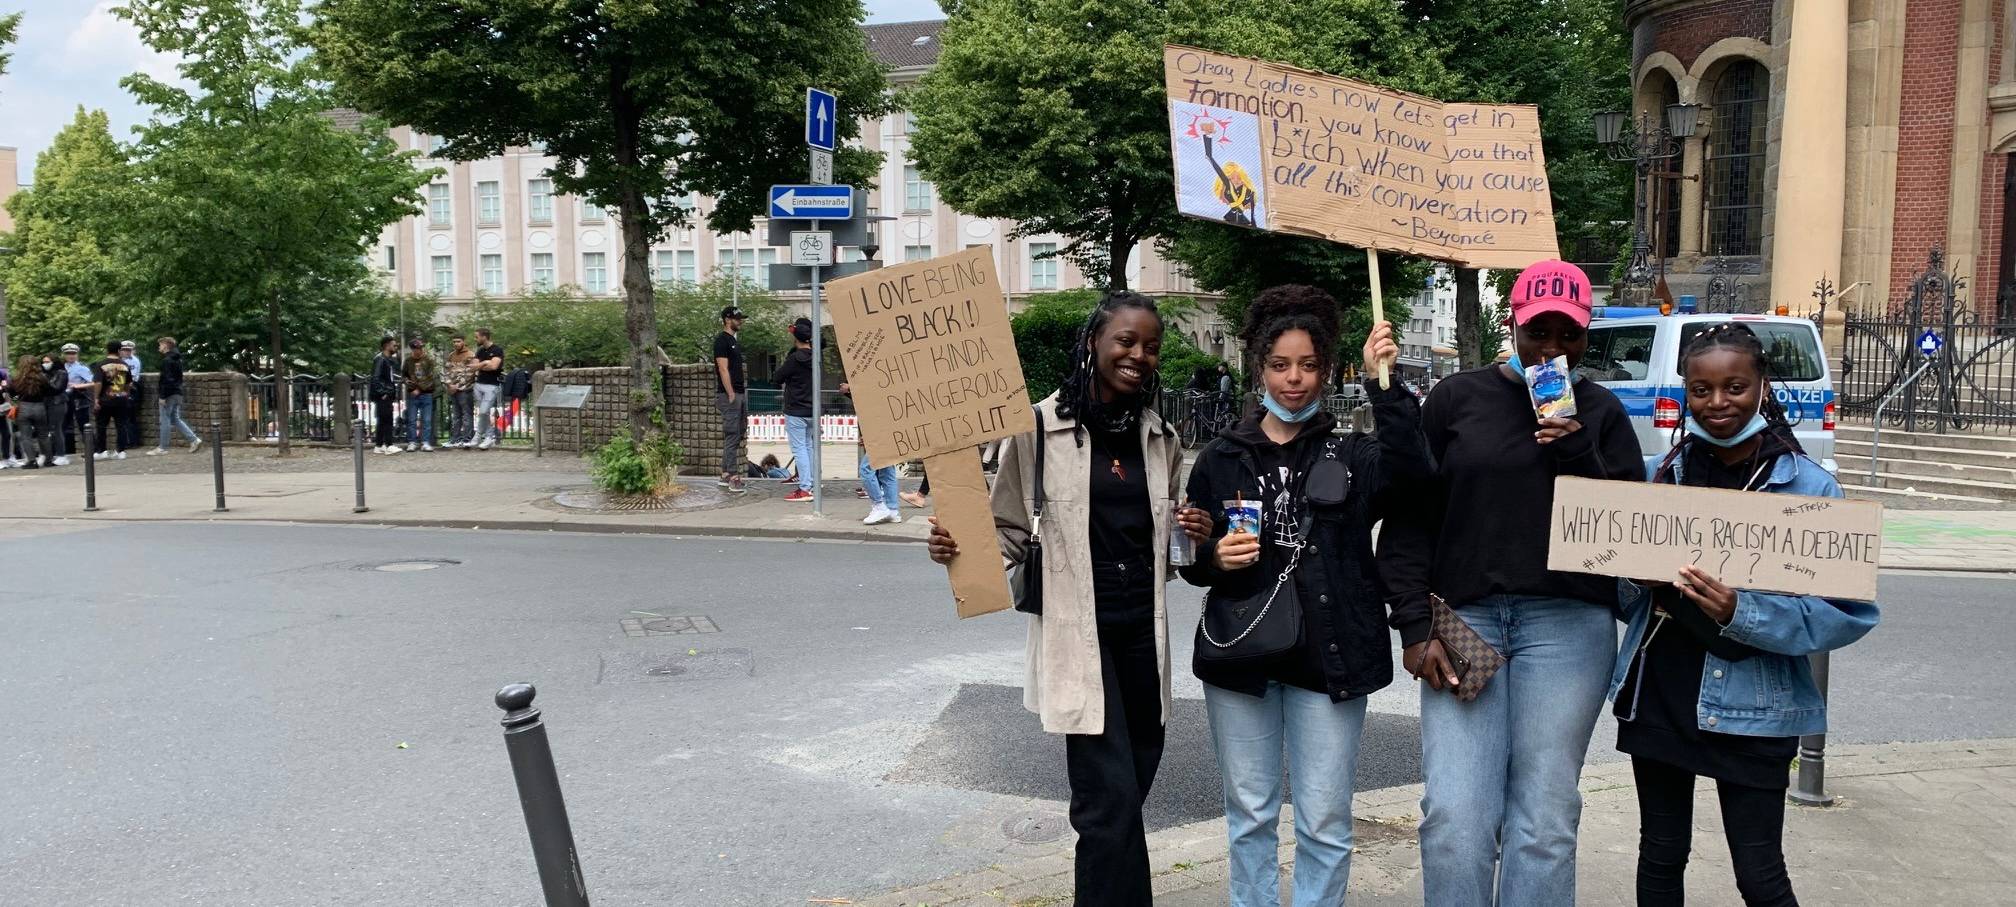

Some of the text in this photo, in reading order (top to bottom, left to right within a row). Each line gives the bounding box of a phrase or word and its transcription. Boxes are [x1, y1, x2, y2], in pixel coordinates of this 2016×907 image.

[1177, 52, 1234, 82] Okay
[1245, 65, 1319, 98] Ladies
[1332, 87, 1381, 113] now
[1444, 109, 1478, 136] get
[1492, 109, 1515, 128] in
[1319, 117, 1362, 138] you
[1373, 118, 1432, 153] know
[1442, 145, 1484, 164] you
[1493, 143, 1535, 163] that
[792, 198, 846, 206] Einbahnstraße
[1274, 162, 1528, 225] all this conversation
[1435, 169, 1474, 194] you
[1483, 172, 1545, 193] cause
[848, 257, 986, 319] I LOVE BEING
[1526, 277, 1580, 302] ICON
[874, 336, 995, 389] SHIT KINDA
[886, 368, 1009, 422] DANGEROUS
[1774, 389, 1825, 404] OLIZEI
[892, 405, 1007, 457] BUT IT'S LIT
[1562, 505, 1878, 564] WHY IS ENDING RACISM A DEBATE
